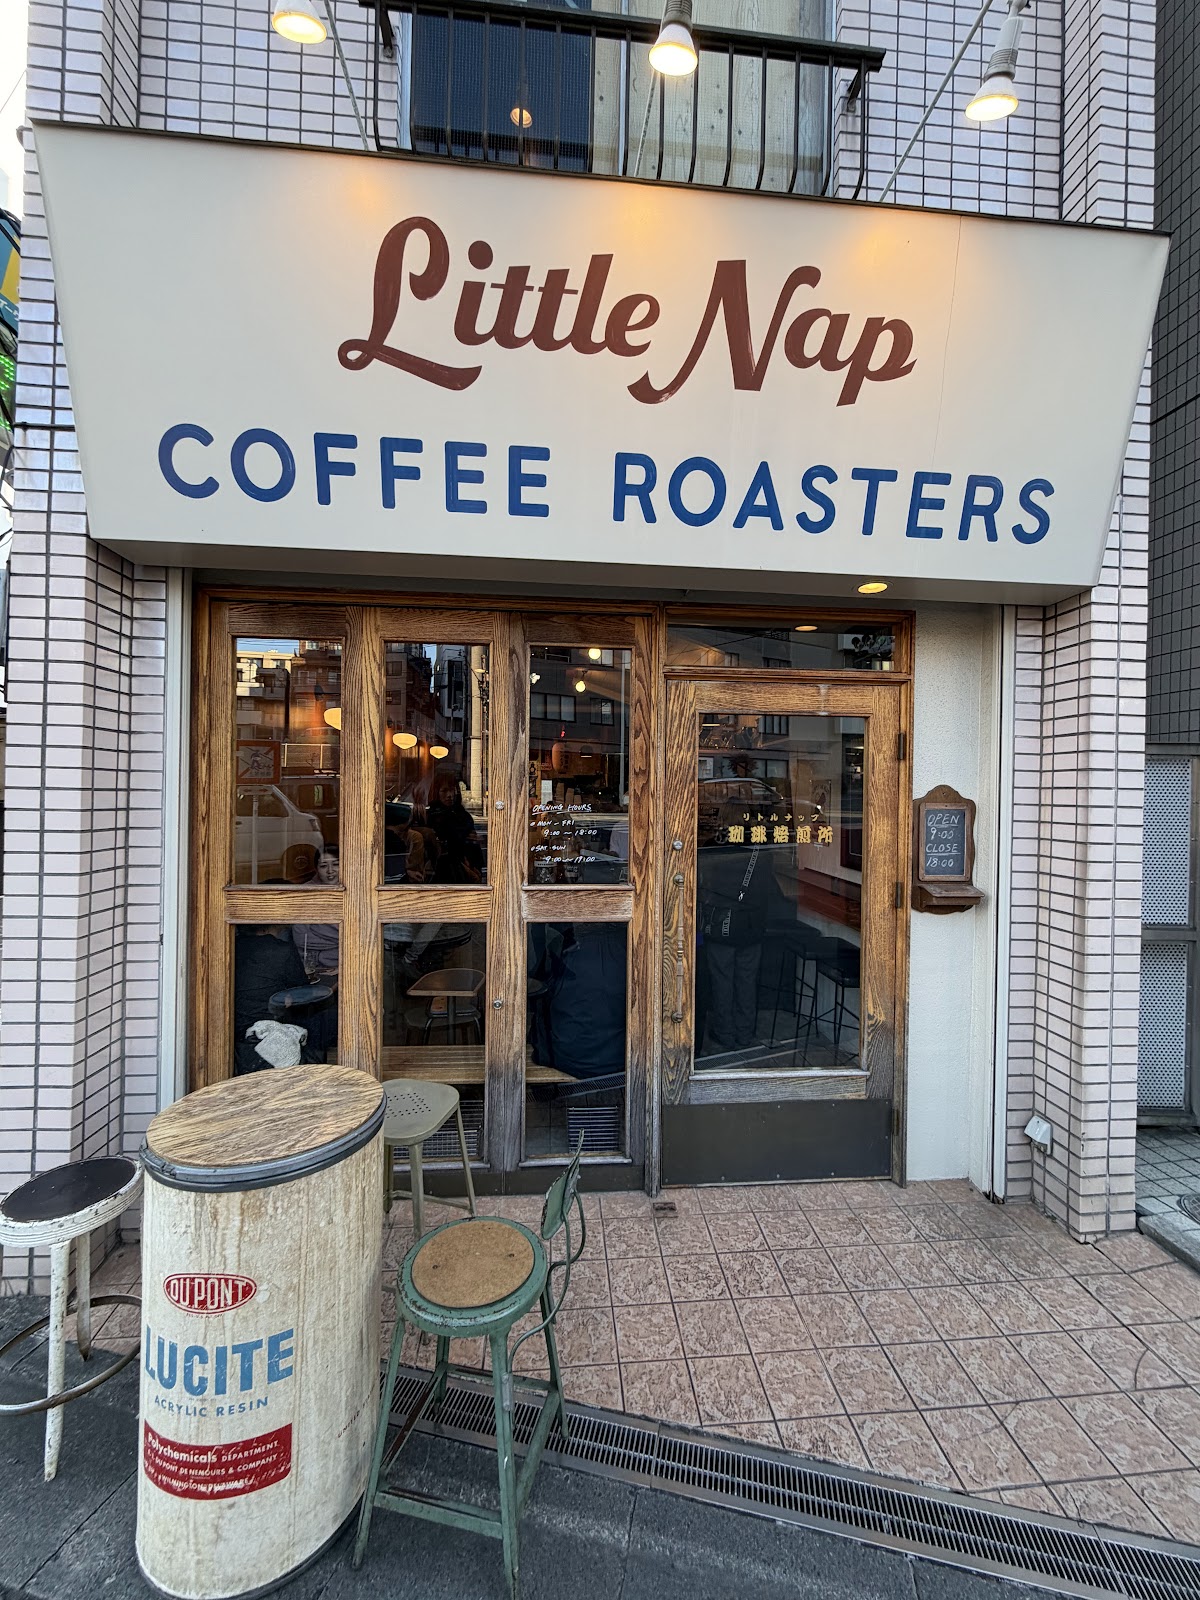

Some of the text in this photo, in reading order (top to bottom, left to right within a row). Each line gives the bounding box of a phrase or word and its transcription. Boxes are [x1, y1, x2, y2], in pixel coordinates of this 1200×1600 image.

[338, 216, 917, 406] Little Nap
[158, 423, 1055, 545] COFFEE ROASTERS
[532, 803, 592, 813] OPENING HOURS
[927, 813, 961, 826] OPEN
[727, 824, 834, 844] 珈琲焙煎所
[930, 827, 954, 841] 9:00
[925, 843, 959, 853] CLOSE
[926, 857, 954, 868] 18:00
[145, 1324, 294, 1397] LUCITE
[154, 1395, 269, 1417] ACRYLIC RESIN
[147, 1432, 279, 1463] Polychemicals DEPARTMENT
[179, 1467, 188, 1475] DE
[189, 1468, 225, 1476] NEMOURS
[237, 1453, 278, 1472] COMPANY
